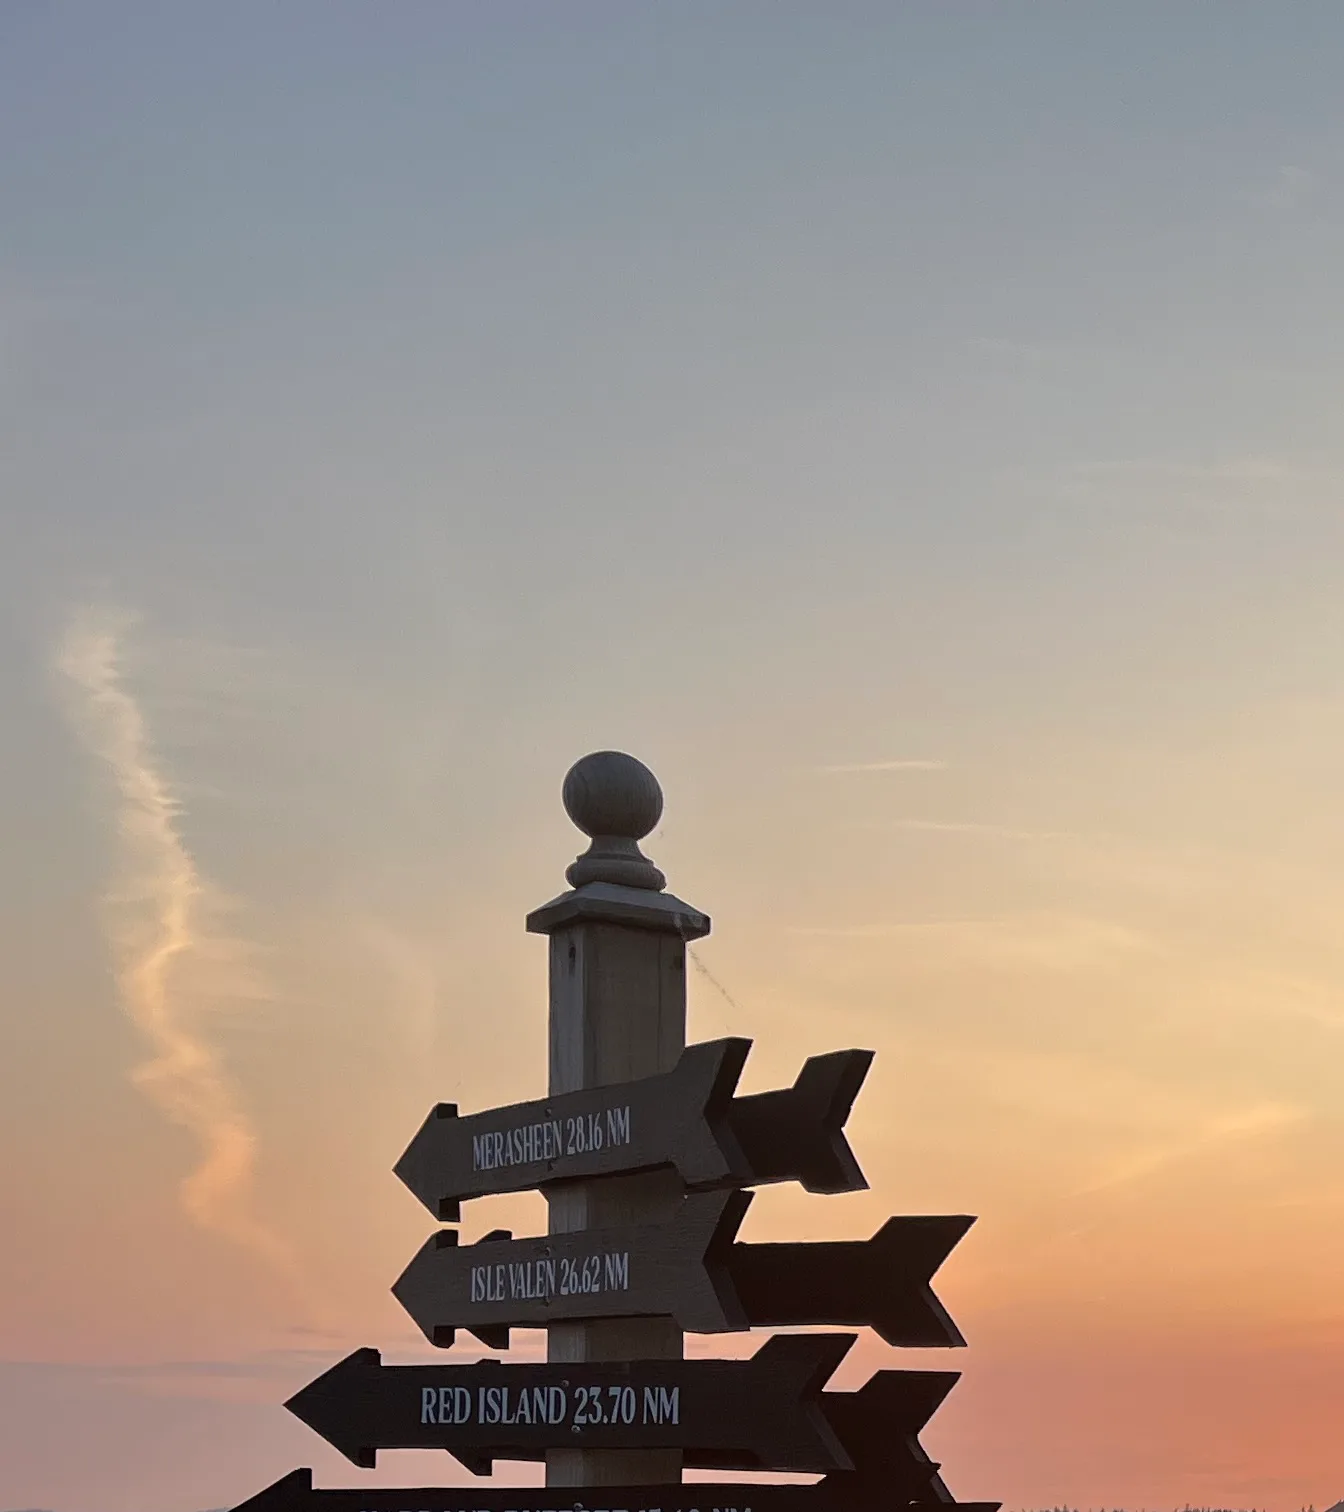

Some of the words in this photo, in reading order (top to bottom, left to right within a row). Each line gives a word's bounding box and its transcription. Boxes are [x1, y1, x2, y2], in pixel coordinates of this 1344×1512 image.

[473, 1120, 562, 1171] MERASHEEN
[566, 1112, 603, 1155] 28.16
[606, 1105, 630, 1147] NM
[471, 1264, 506, 1302] ISLE
[508, 1259, 556, 1299] VALEN
[560, 1255, 600, 1296] 26.62
[604, 1252, 629, 1291] NM
[421, 1387, 471, 1424] RED
[478, 1386, 567, 1424] ISLAND
[572, 1386, 636, 1425] 23.70
[642, 1386, 680, 1425] NM
